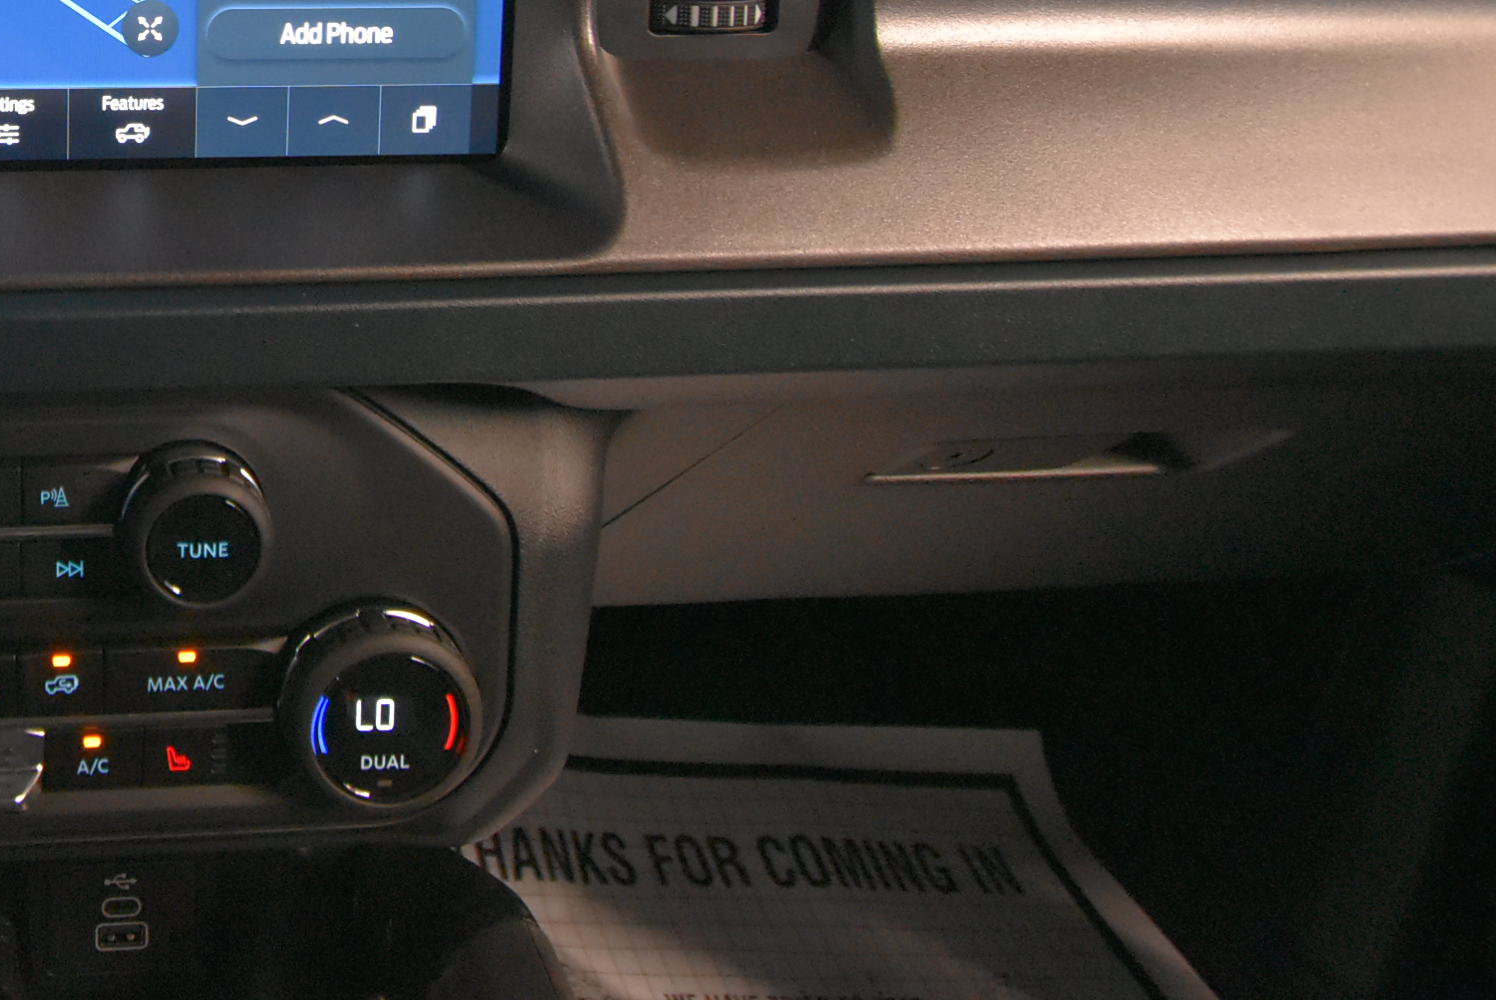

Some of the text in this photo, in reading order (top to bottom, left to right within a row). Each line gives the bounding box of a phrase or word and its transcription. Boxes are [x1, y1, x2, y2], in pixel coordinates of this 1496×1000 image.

[279, 22, 394, 46] Add Phone
[101, 94, 165, 113] Features
[176, 541, 230, 560] TUNE
[147, 672, 226, 694] MAX A/C
[76, 756, 110, 776] A/C
[360, 753, 411, 771] DUAL
[474, 826, 1027, 897] HANKS FOR COMING IN
